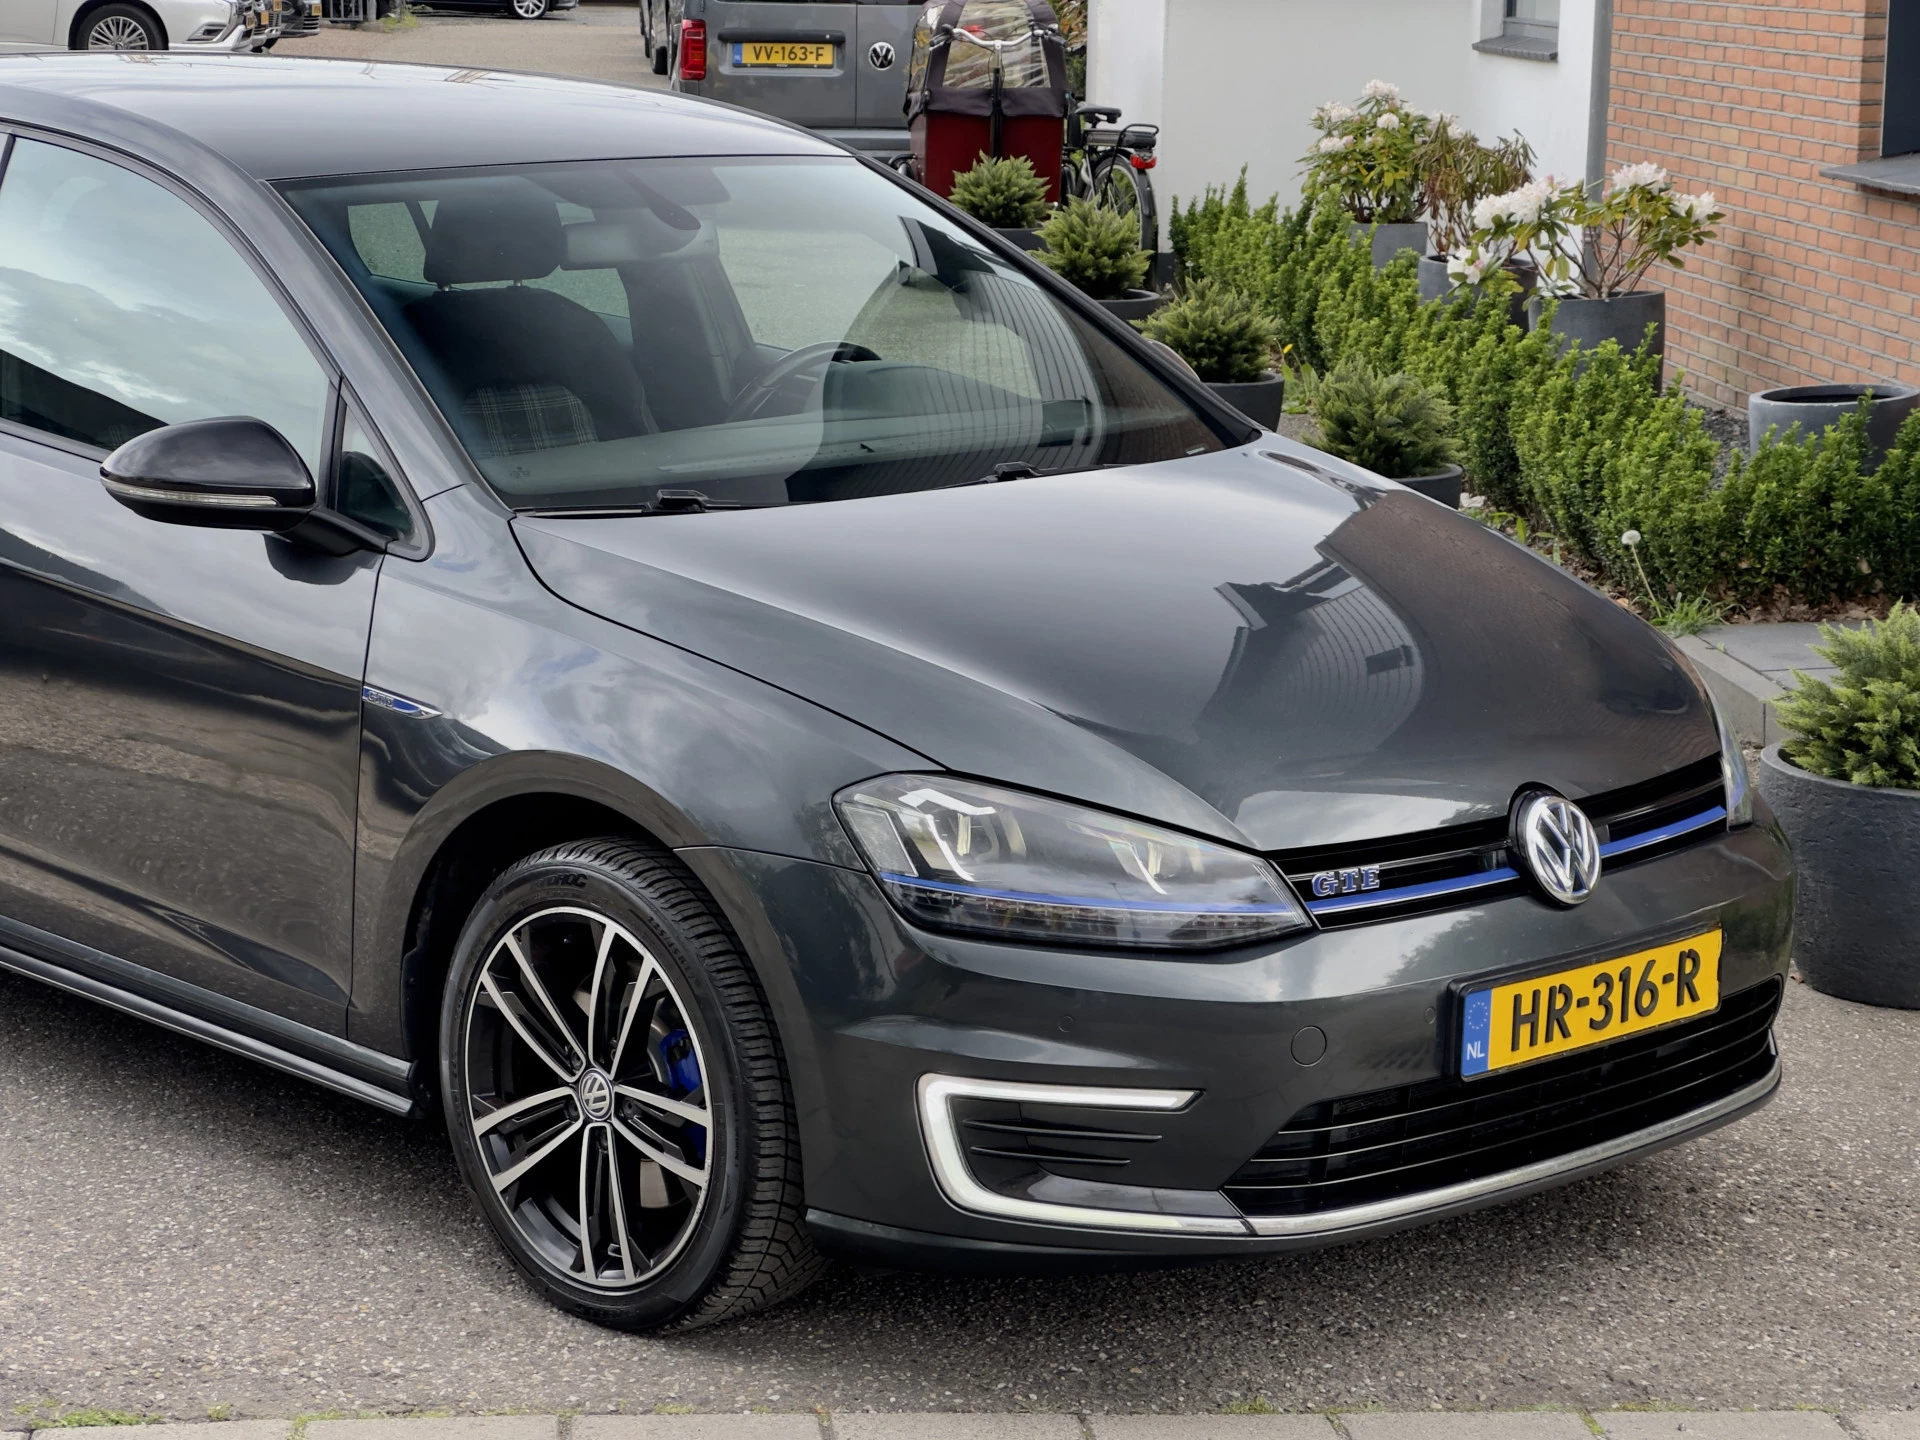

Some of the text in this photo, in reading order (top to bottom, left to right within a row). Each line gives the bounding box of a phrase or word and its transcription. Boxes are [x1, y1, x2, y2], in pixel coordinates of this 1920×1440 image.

[752, 45, 825, 61] VV-163-F
[1311, 865, 1380, 897] GTE
[1466, 948, 1701, 1061] NL HR-316-R
